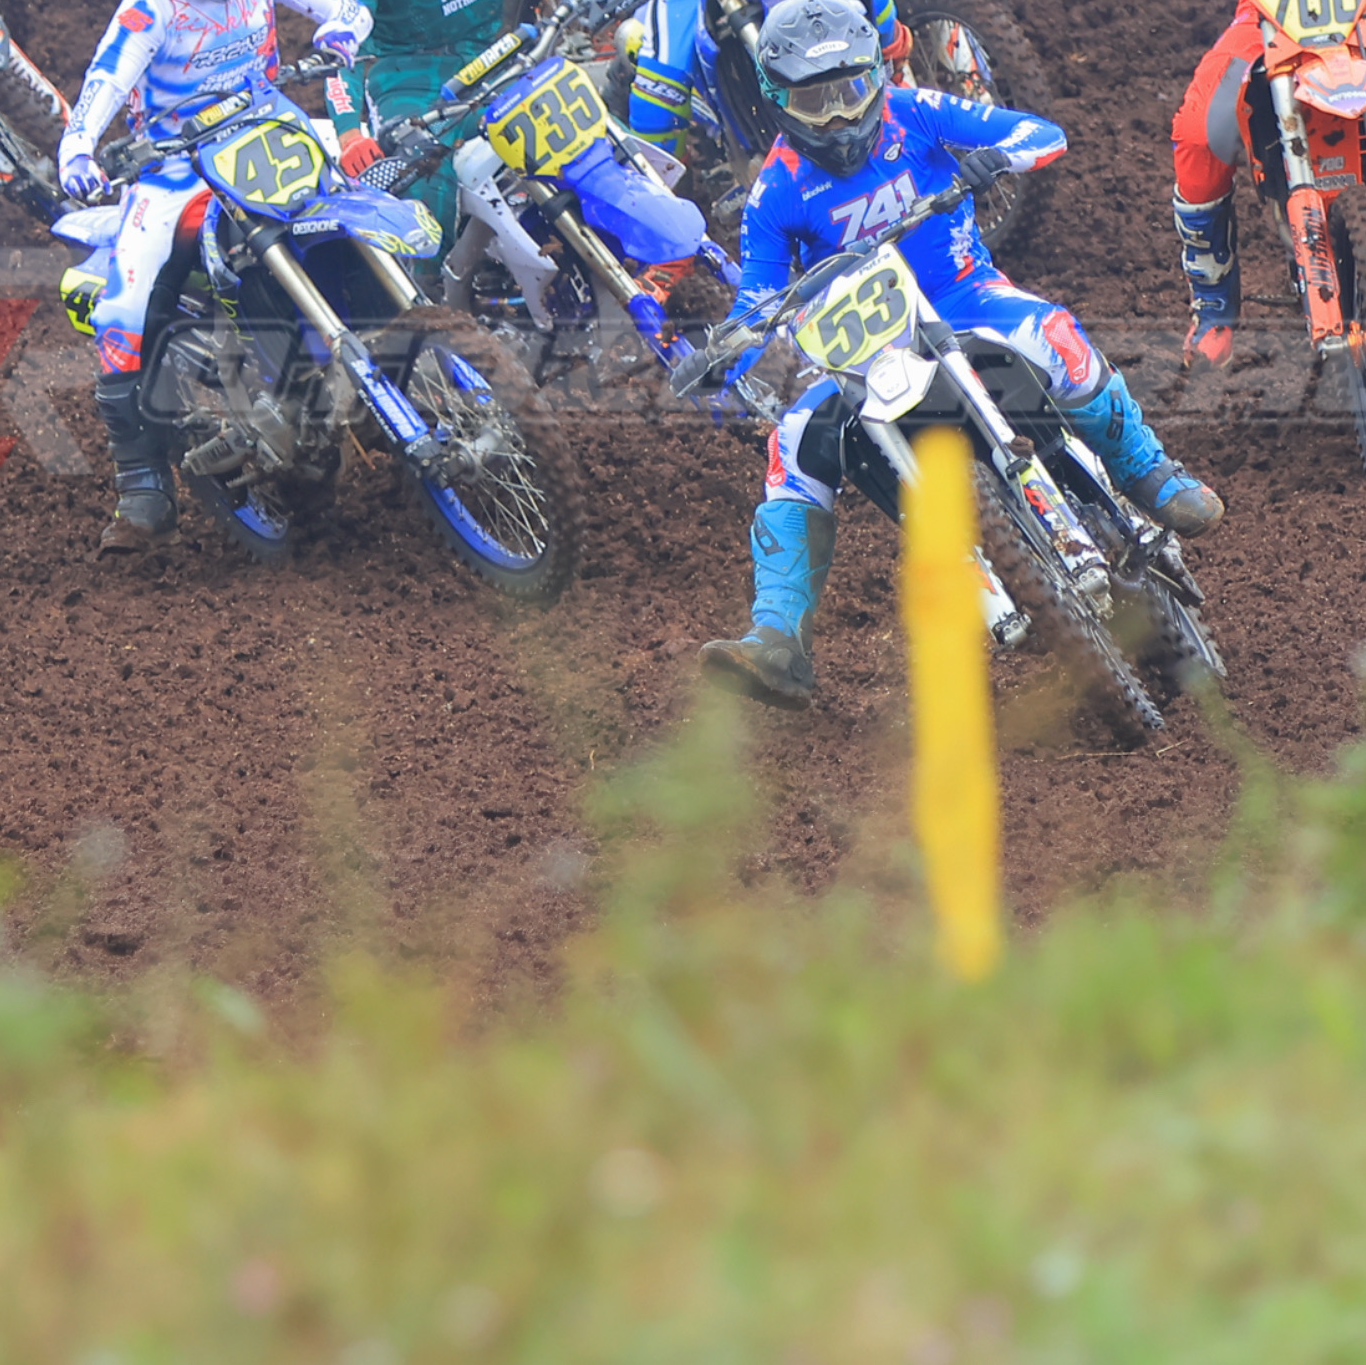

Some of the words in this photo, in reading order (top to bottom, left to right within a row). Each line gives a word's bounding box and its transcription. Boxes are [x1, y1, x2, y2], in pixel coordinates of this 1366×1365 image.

[502, 69, 602, 175] 235
[235, 123, 315, 200] 45
[291, 218, 340, 236] DESIGNONE
[829, 171, 919, 249] 741
[816, 268, 907, 368] 53
